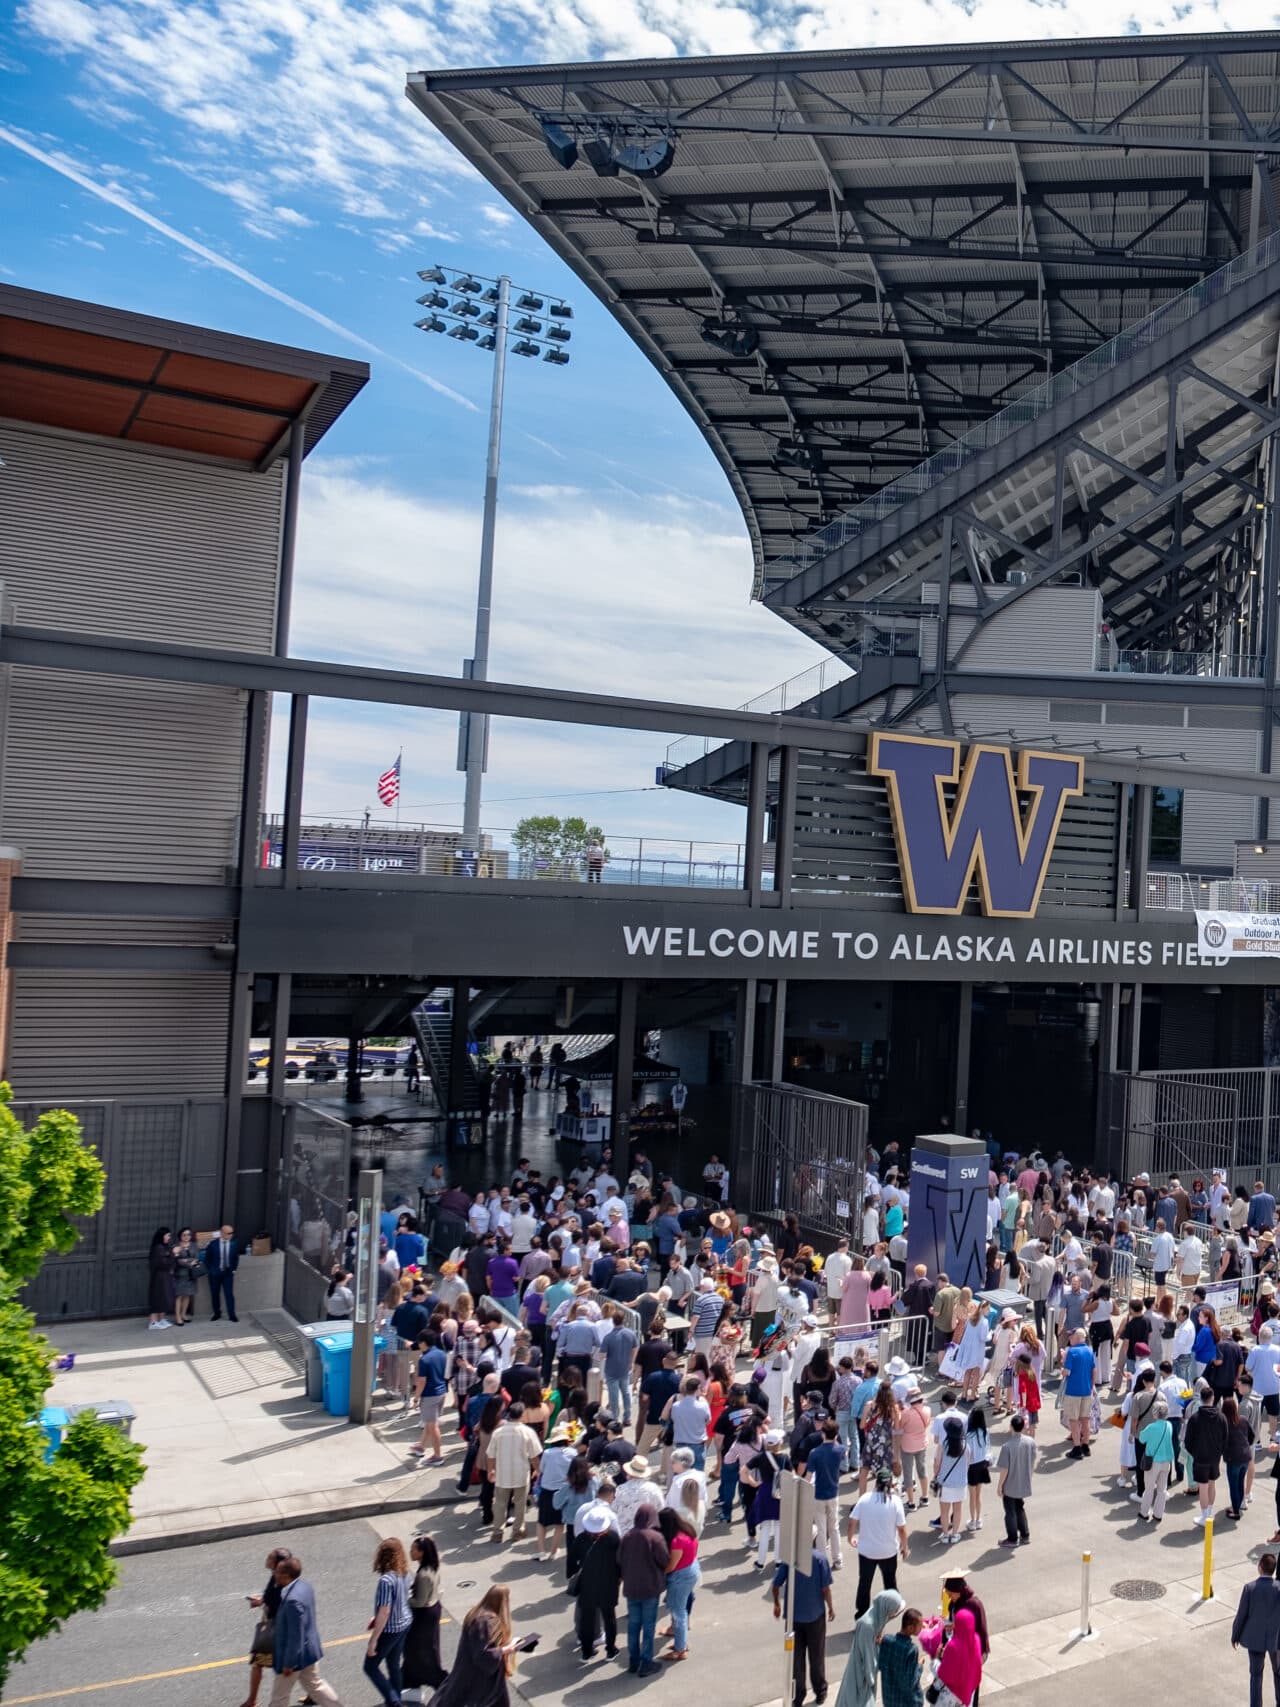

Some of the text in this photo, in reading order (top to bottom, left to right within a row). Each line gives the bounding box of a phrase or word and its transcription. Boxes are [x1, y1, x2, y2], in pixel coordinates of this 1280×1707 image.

[867, 731, 1085, 918] W
[1244, 927, 1273, 939] Outdoor
[622, 925, 820, 958] WELCOME
[832, 932, 879, 960] TO
[889, 933, 1016, 962] ALASKA
[1025, 938, 1153, 966] AIRLINES
[1245, 941, 1263, 951] Gold
[960, 1167, 979, 1179] SW
